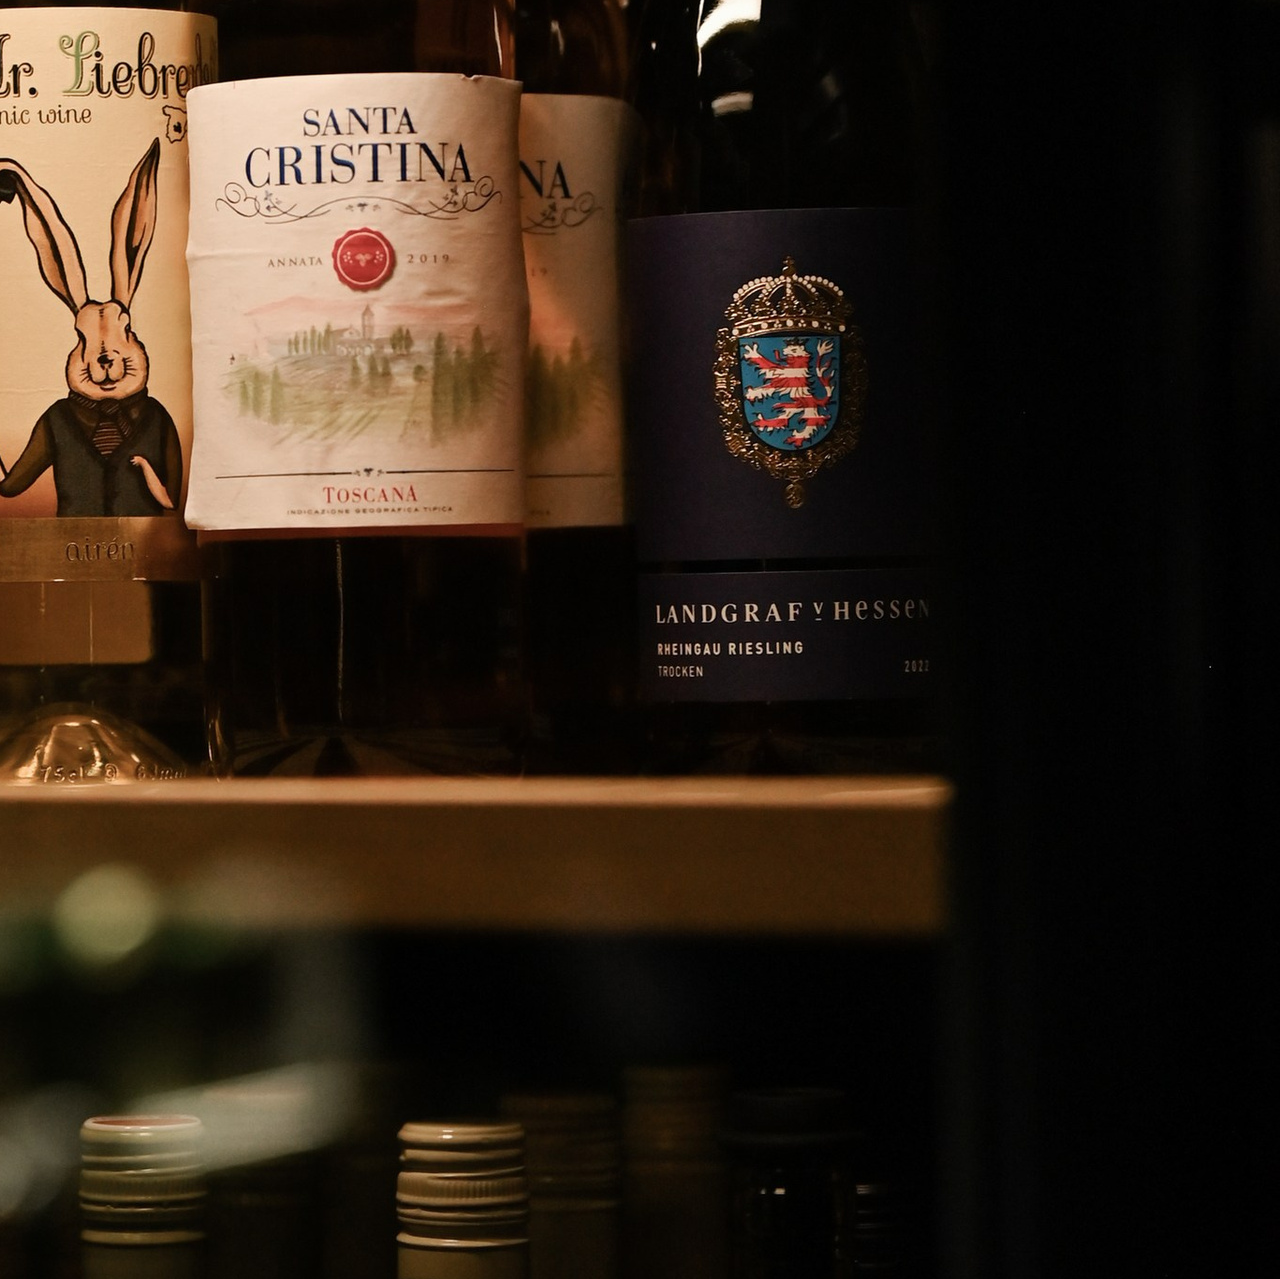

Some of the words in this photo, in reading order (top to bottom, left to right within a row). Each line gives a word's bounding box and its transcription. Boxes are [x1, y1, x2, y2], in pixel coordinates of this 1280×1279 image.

[59, 30, 188, 100] Liebre
[37, 104, 93, 125] wine
[302, 106, 419, 137] SANTA
[245, 142, 475, 189] CRISTINA
[520, 160, 573, 198] NA
[267, 256, 324, 268] ANNATA
[407, 253, 451, 264] 2019
[322, 485, 418, 504] TOSCANA
[66, 536, 135, 563] airén
[656, 602, 803, 624] LANDGRAF
[657, 642, 721, 656] RHEINGAU
[728, 640, 804, 656] RIESLING
[658, 665, 704, 678] TROCKEN
